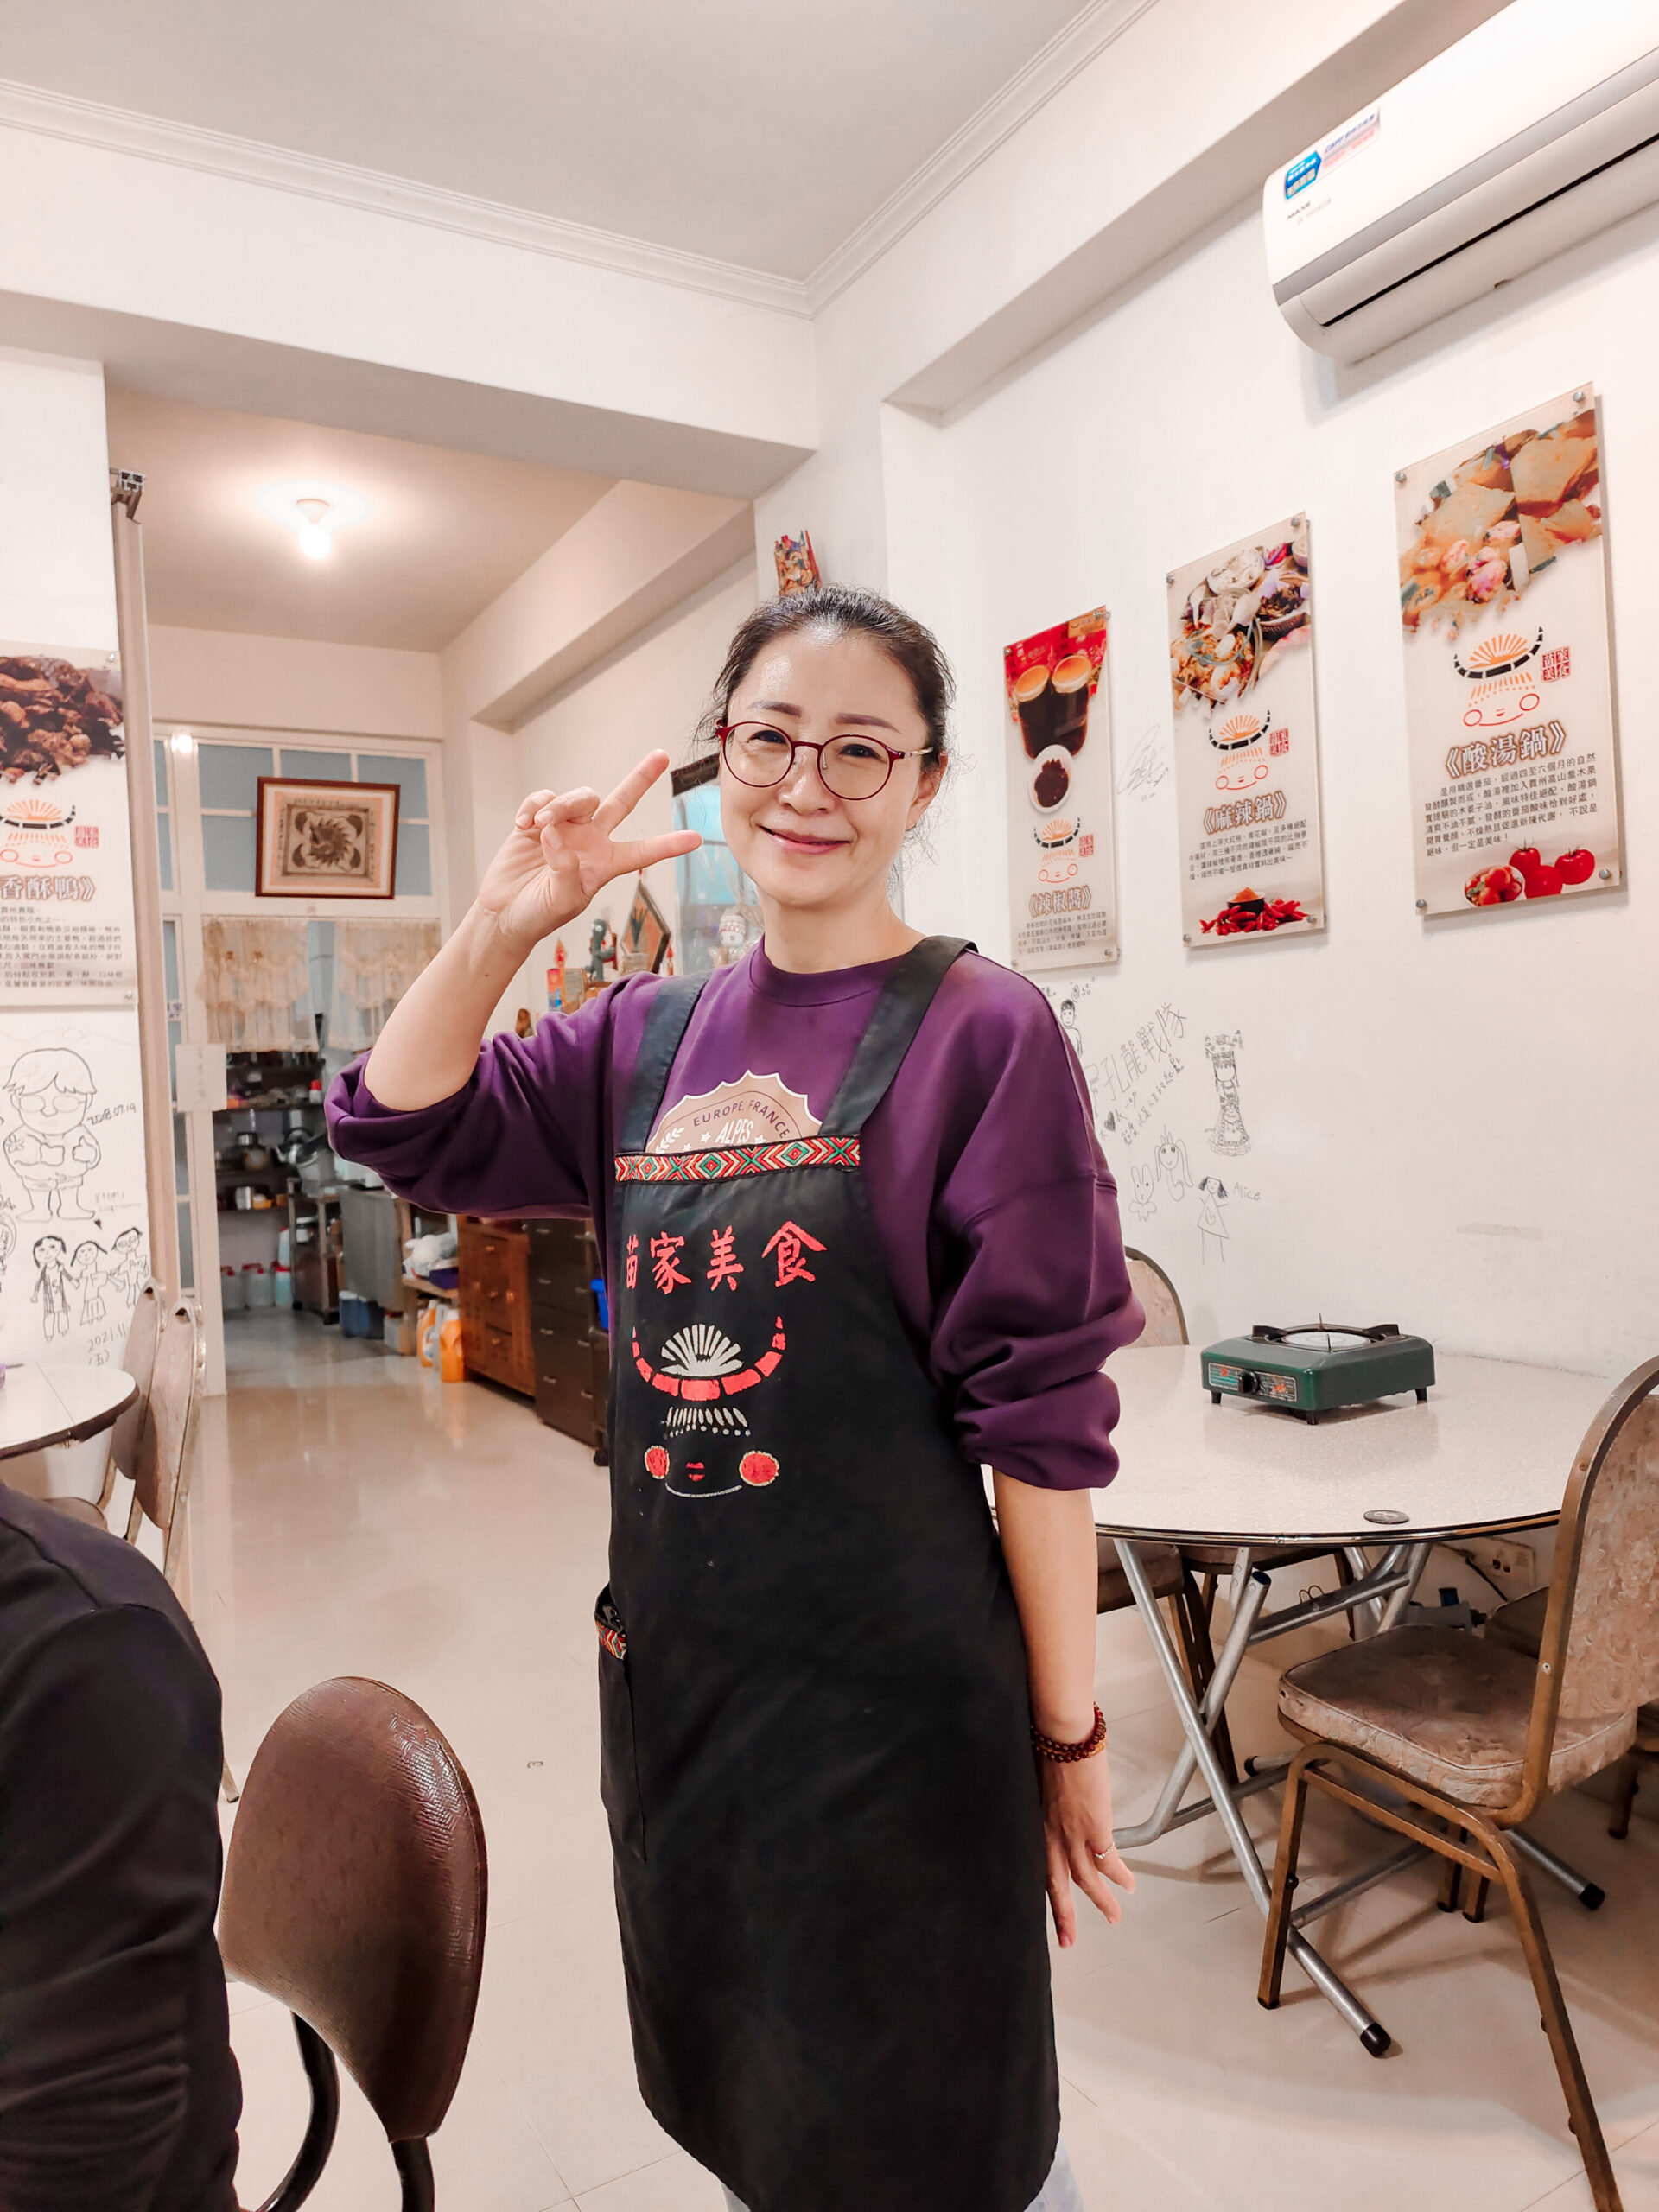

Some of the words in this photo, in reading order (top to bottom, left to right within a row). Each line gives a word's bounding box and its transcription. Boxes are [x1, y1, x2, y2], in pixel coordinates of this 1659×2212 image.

[1445, 721, 1567, 779] 《酸湯鍋》
[1203, 791, 1287, 836] 《麻辣鍋》
[1028, 885, 1093, 918] 《辣椒醬》
[693, 1100, 746, 1128] EUROPE,
[748, 1098, 791, 1139] FRANCE
[714, 1117, 755, 1146] ALPES
